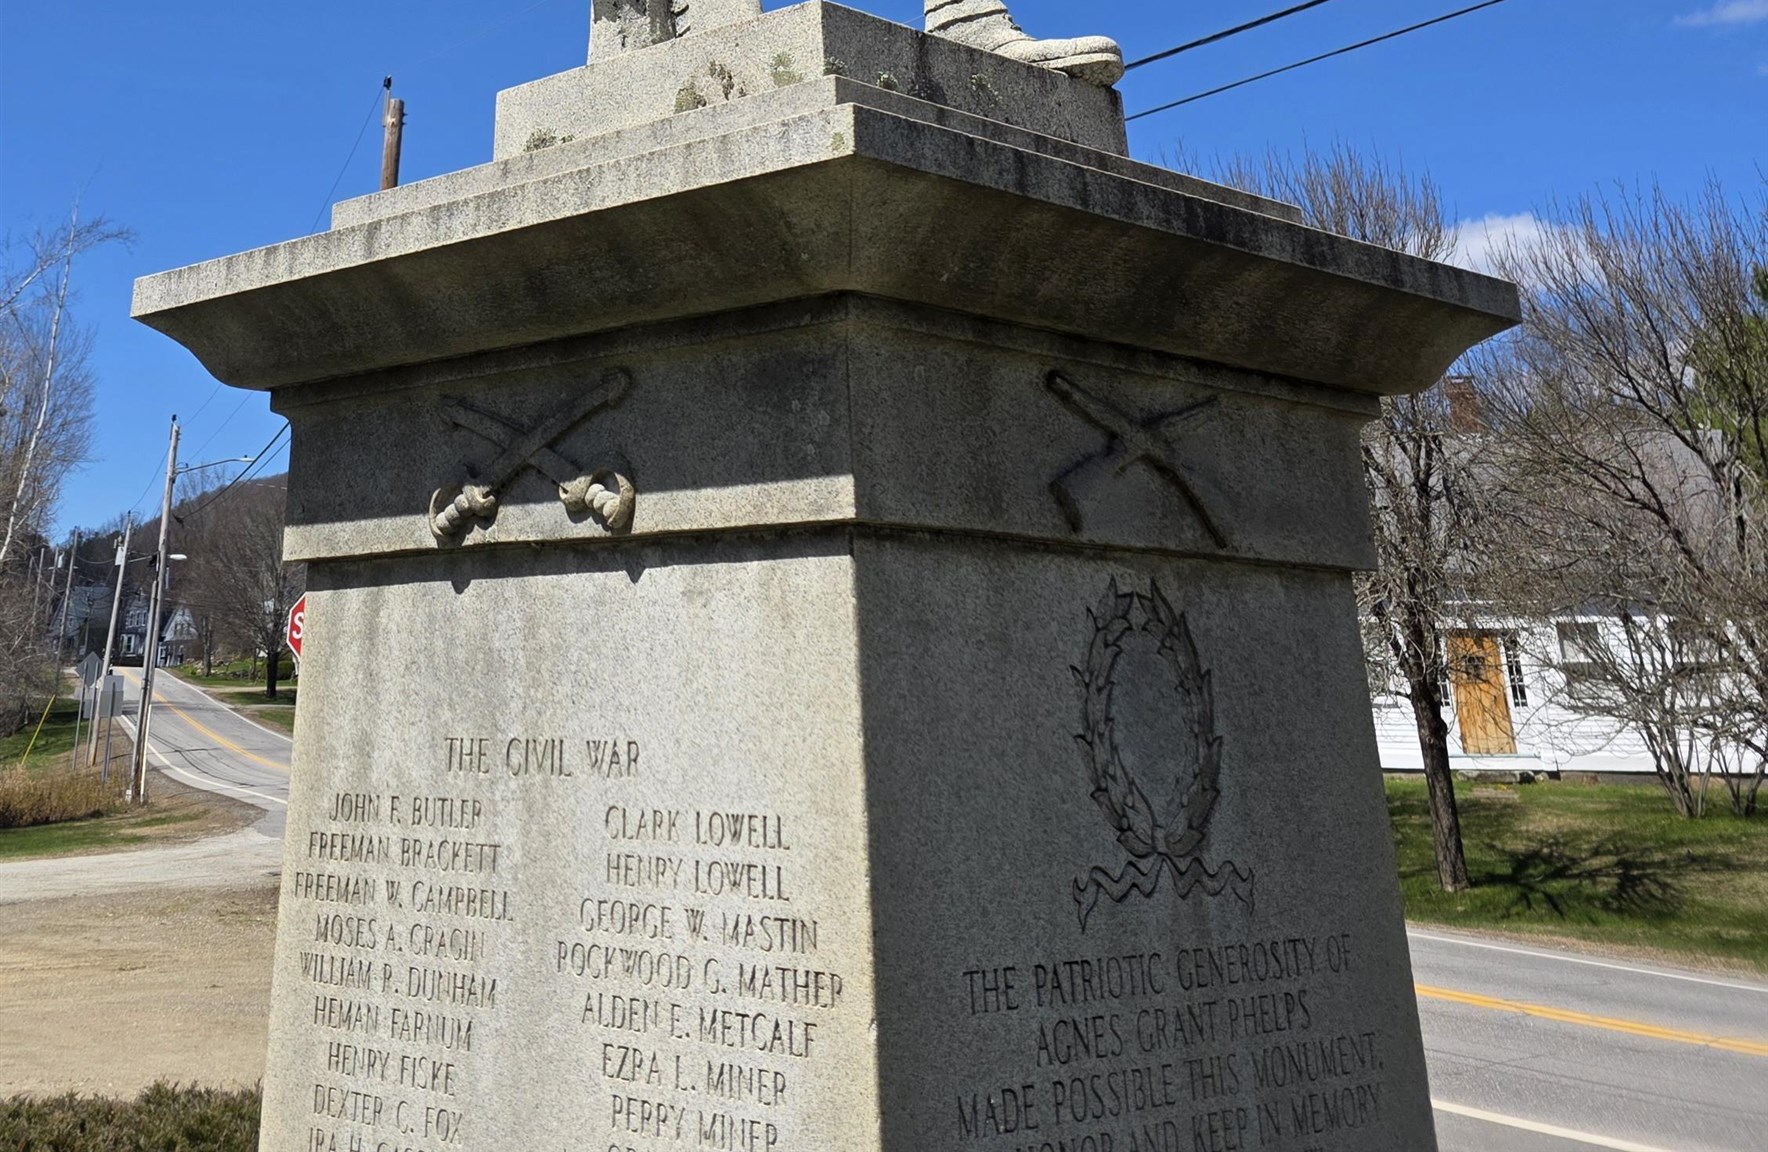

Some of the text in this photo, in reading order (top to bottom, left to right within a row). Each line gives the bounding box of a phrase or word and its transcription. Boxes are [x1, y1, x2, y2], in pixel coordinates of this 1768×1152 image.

[445, 737, 640, 778] THE CIVIL WAR
[329, 793, 380, 823] JOHN
[411, 797, 482, 829] BUTLER
[605, 805, 791, 850] CLARK LOWELL
[308, 831, 501, 873] FREEMAN BRACKETT
[606, 853, 790, 901] HENRY LOWELL
[294, 871, 514, 921] FREEMAN W. CAMPBELL
[315, 914, 485, 962] MOSES A. CRAGIN
[580, 898, 818, 954] GEORGE W. MASTIN
[300, 951, 372, 990] WILLIAM
[408, 966, 498, 1009] DUNHAM
[557, 940, 692, 990] ROCKWOOD
[738, 962, 843, 1009] MATHER
[963, 934, 1351, 1015] THE PATRIOTIC GENEROSITY OF
[314, 996, 473, 1051] HEMAN FARNUM
[581, 993, 818, 1058] ALDEN E. METCALF
[1036, 989, 1311, 1068] AGNES GRANT PHELPS
[328, 1042, 455, 1097] HENRY FISKE
[602, 1043, 787, 1106] EZRA L. MINER
[957, 1032, 1384, 1141] MADE POSSIBLE THIS MONUMENT.
[314, 1084, 384, 1128] DEXTER
[424, 1106, 463, 1146] FOX
[611, 1094, 778, 1152] PERRY MINER
[1130, 1120, 1180, 1152] AND
[1191, 1107, 1247, 1152] KEEP
[1256, 1101, 1281, 1147] IN
[1291, 1083, 1383, 1140] MEMORY
